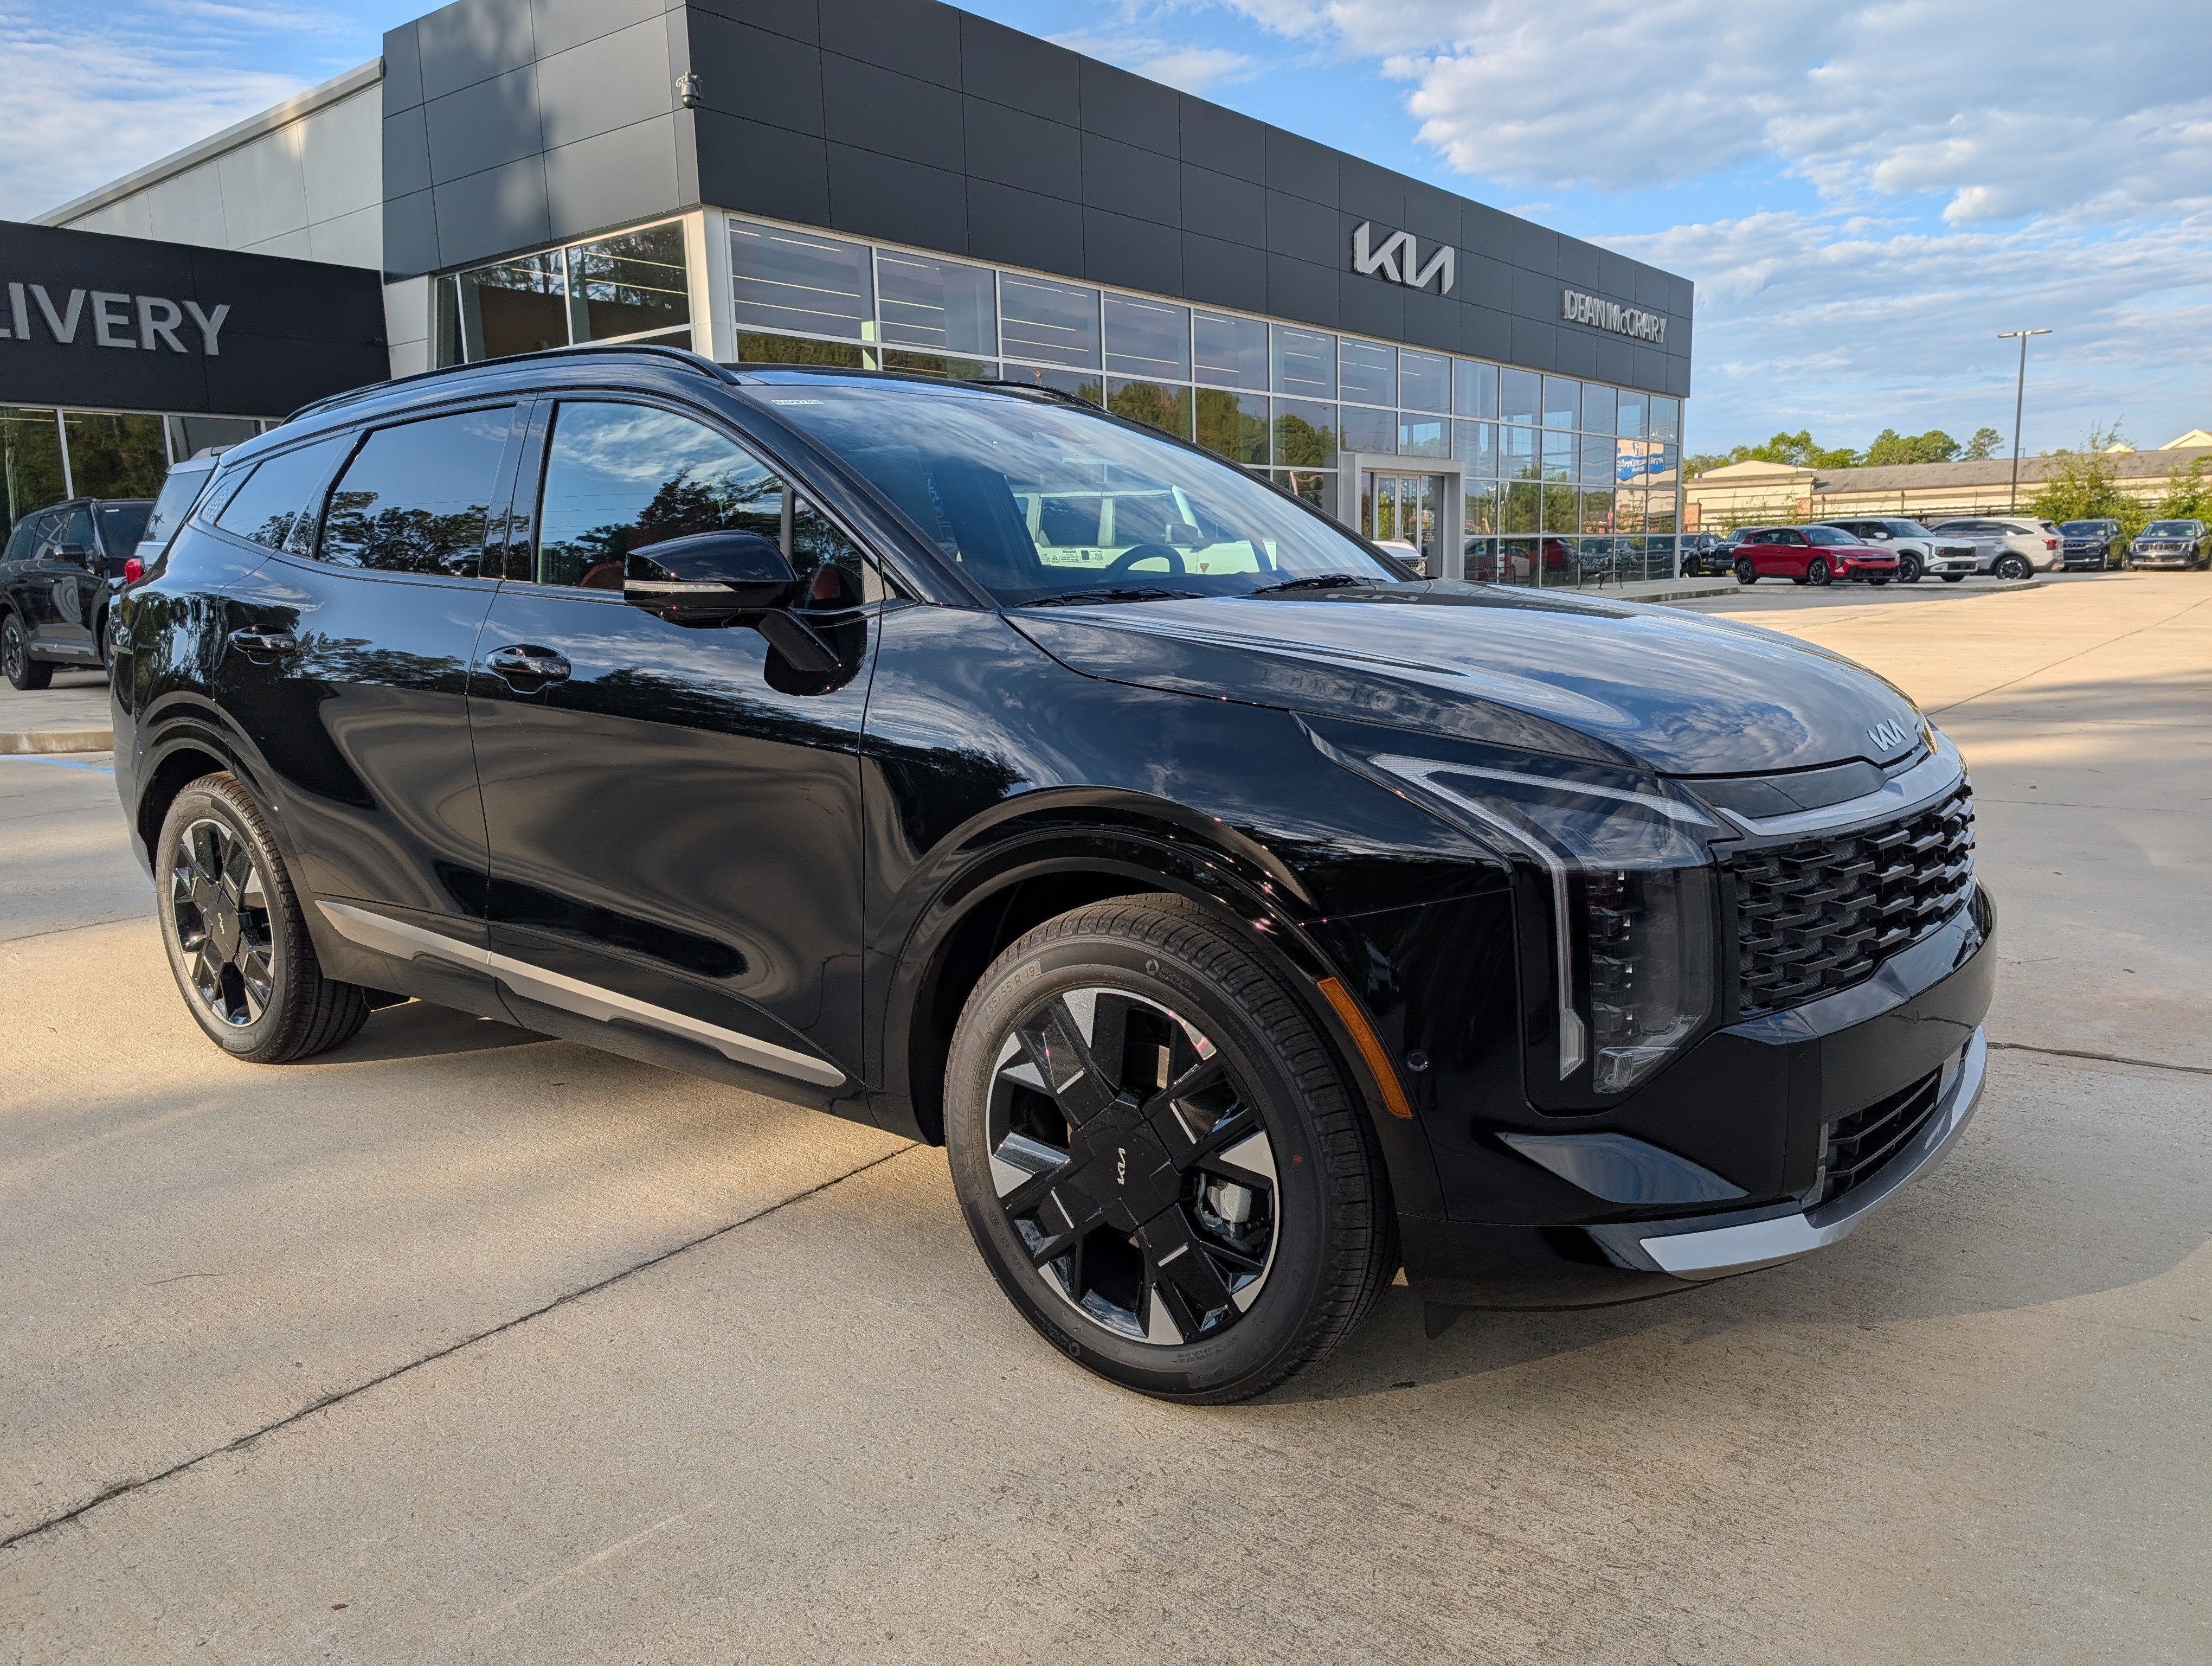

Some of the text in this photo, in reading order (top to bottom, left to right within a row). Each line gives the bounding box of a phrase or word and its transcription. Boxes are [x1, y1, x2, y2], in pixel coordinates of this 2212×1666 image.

[1354, 221, 1454, 294] KIA
[0, 283, 230, 355] IVERY
[1564, 290, 1666, 343] DEAN McCRARY
[1867, 719, 1907, 752] KIA
[983, 984, 1013, 1019] 235/55
[1014, 974, 1023, 987] R
[1024, 965, 1036, 979] 19
[1161, 966, 1193, 989] MICHELIN
[1117, 1147, 1126, 1185] KIA
